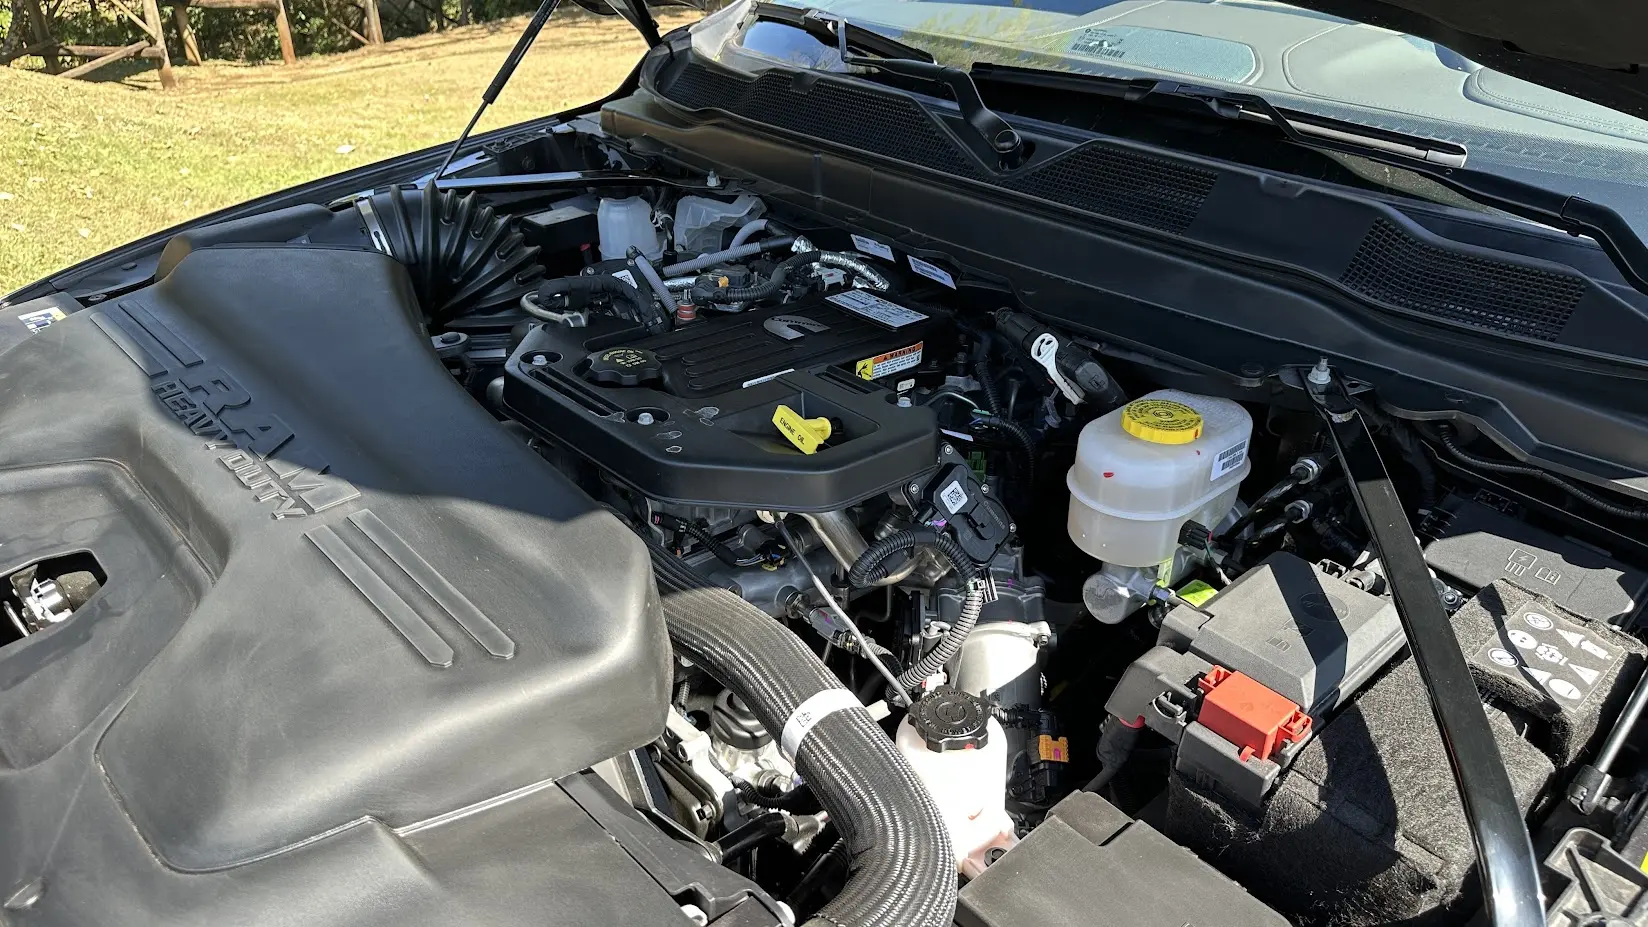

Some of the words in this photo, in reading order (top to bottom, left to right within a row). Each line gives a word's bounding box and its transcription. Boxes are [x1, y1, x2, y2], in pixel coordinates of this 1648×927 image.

[890, 345, 917, 359] WARNING
[151, 380, 238, 451] HEAVY
[218, 448, 308, 521] DUTY
[178, 364, 362, 513] RAM
[779, 416, 796, 436] ENGINE
[797, 434, 805, 446] OIL
